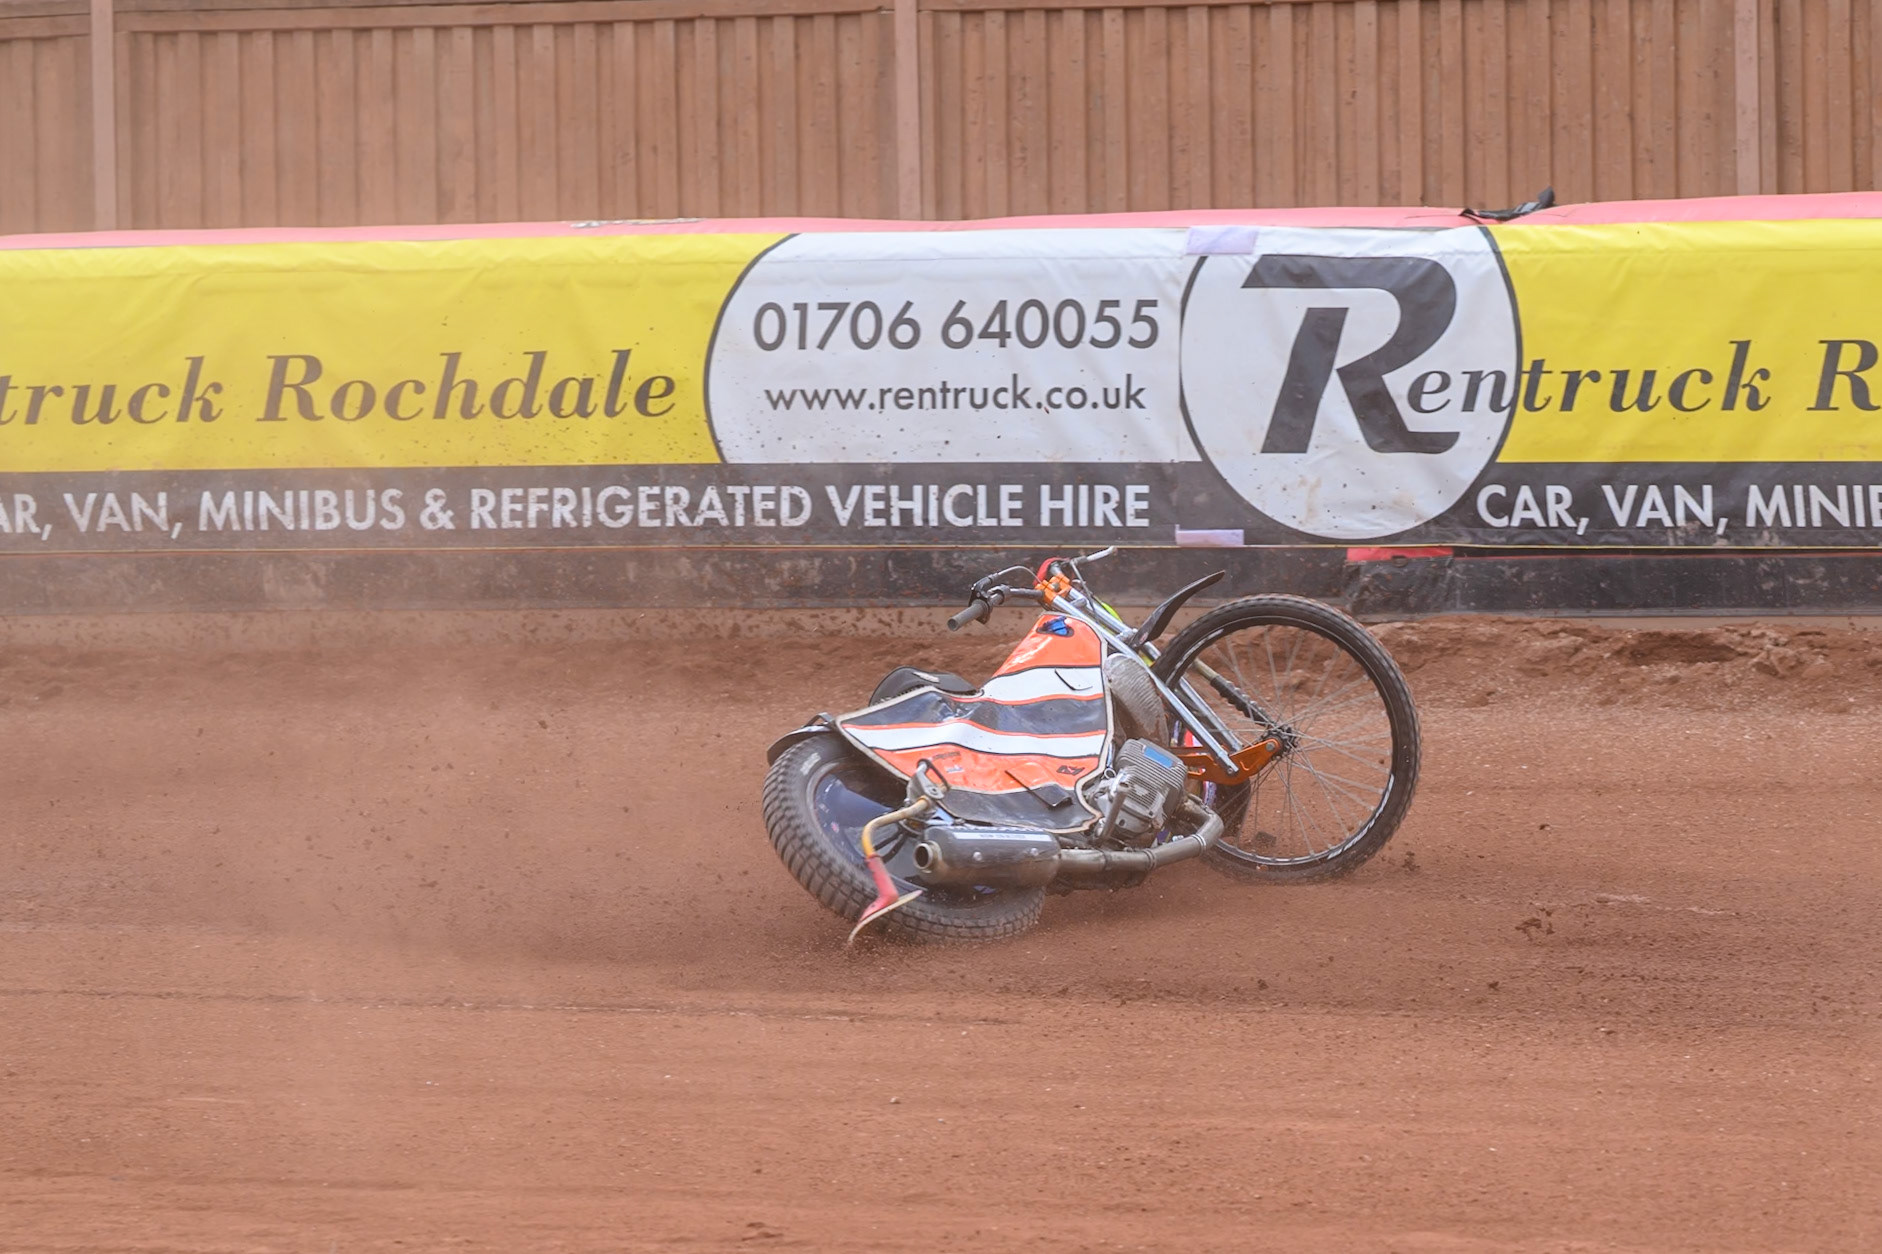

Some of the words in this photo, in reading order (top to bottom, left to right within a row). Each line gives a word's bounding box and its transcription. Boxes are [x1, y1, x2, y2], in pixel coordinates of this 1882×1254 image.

[753, 300, 921, 351] 01706
[941, 299, 1160, 350] 640055
[1241, 253, 1771, 454] Rentruck
[256, 349, 677, 422] Rochdale
[764, 373, 1147, 411] www.rentruck.co.uk
[63, 492, 183, 539] VAN,
[199, 489, 405, 531] MINIBUS
[420, 489, 454, 530] &
[471, 485, 812, 529] REFRIGERATED
[825, 484, 1024, 528] VEHICLE
[1040, 484, 1151, 528] HIRE
[1476, 484, 1589, 536] CAR,
[1602, 484, 1729, 535] VAN,
